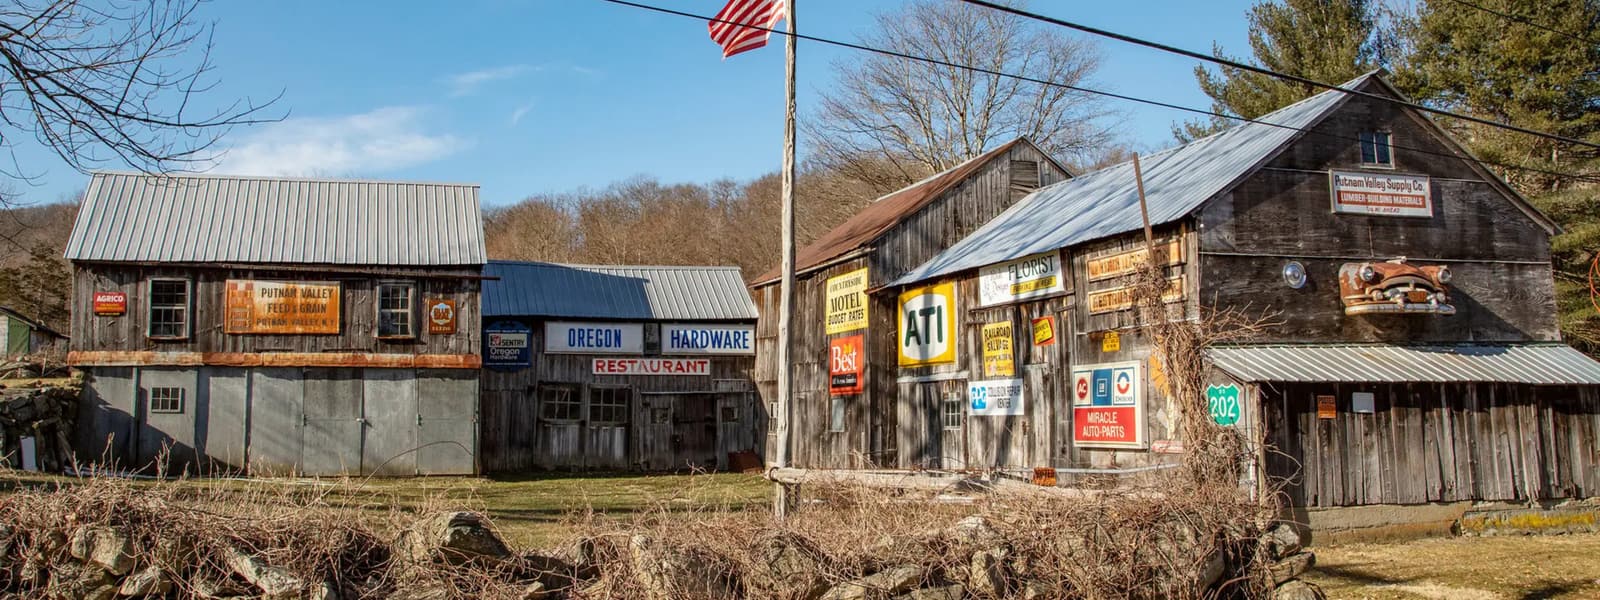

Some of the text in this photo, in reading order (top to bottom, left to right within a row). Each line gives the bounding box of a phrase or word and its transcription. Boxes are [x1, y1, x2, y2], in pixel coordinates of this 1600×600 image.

[1335, 175, 1425, 193] Putnam Valley Supply Co.
[1008, 254, 1055, 281] FLORIST
[97, 295, 124, 303] AGRICO
[261, 287, 333, 298] PUTNAM VALLEY
[268, 303, 290, 313] FEED
[300, 303, 327, 314] GRAIN
[831, 291, 862, 313] MOTEL
[256, 318, 288, 326] PUTNAM
[829, 308, 864, 325] BUDGET RATES
[905, 304, 943, 347] ATI
[568, 328, 750, 349] OREGON HARDWARE
[984, 325, 1010, 341] RAILROAD
[490, 347, 520, 356] Oregon
[987, 339, 1009, 352] SALVAGE
[832, 346, 857, 372] Best
[595, 359, 709, 374] RESTAURANT
[988, 385, 1021, 397] COLLISION REPAIR
[1078, 383, 1087, 394] AC
[972, 386, 986, 408] PPG
[997, 398, 1011, 409] CENTER
[1210, 396, 1236, 417] 202
[1087, 411, 1118, 424] MIRACLE
[1082, 425, 1125, 438] AUTO-PARTS
